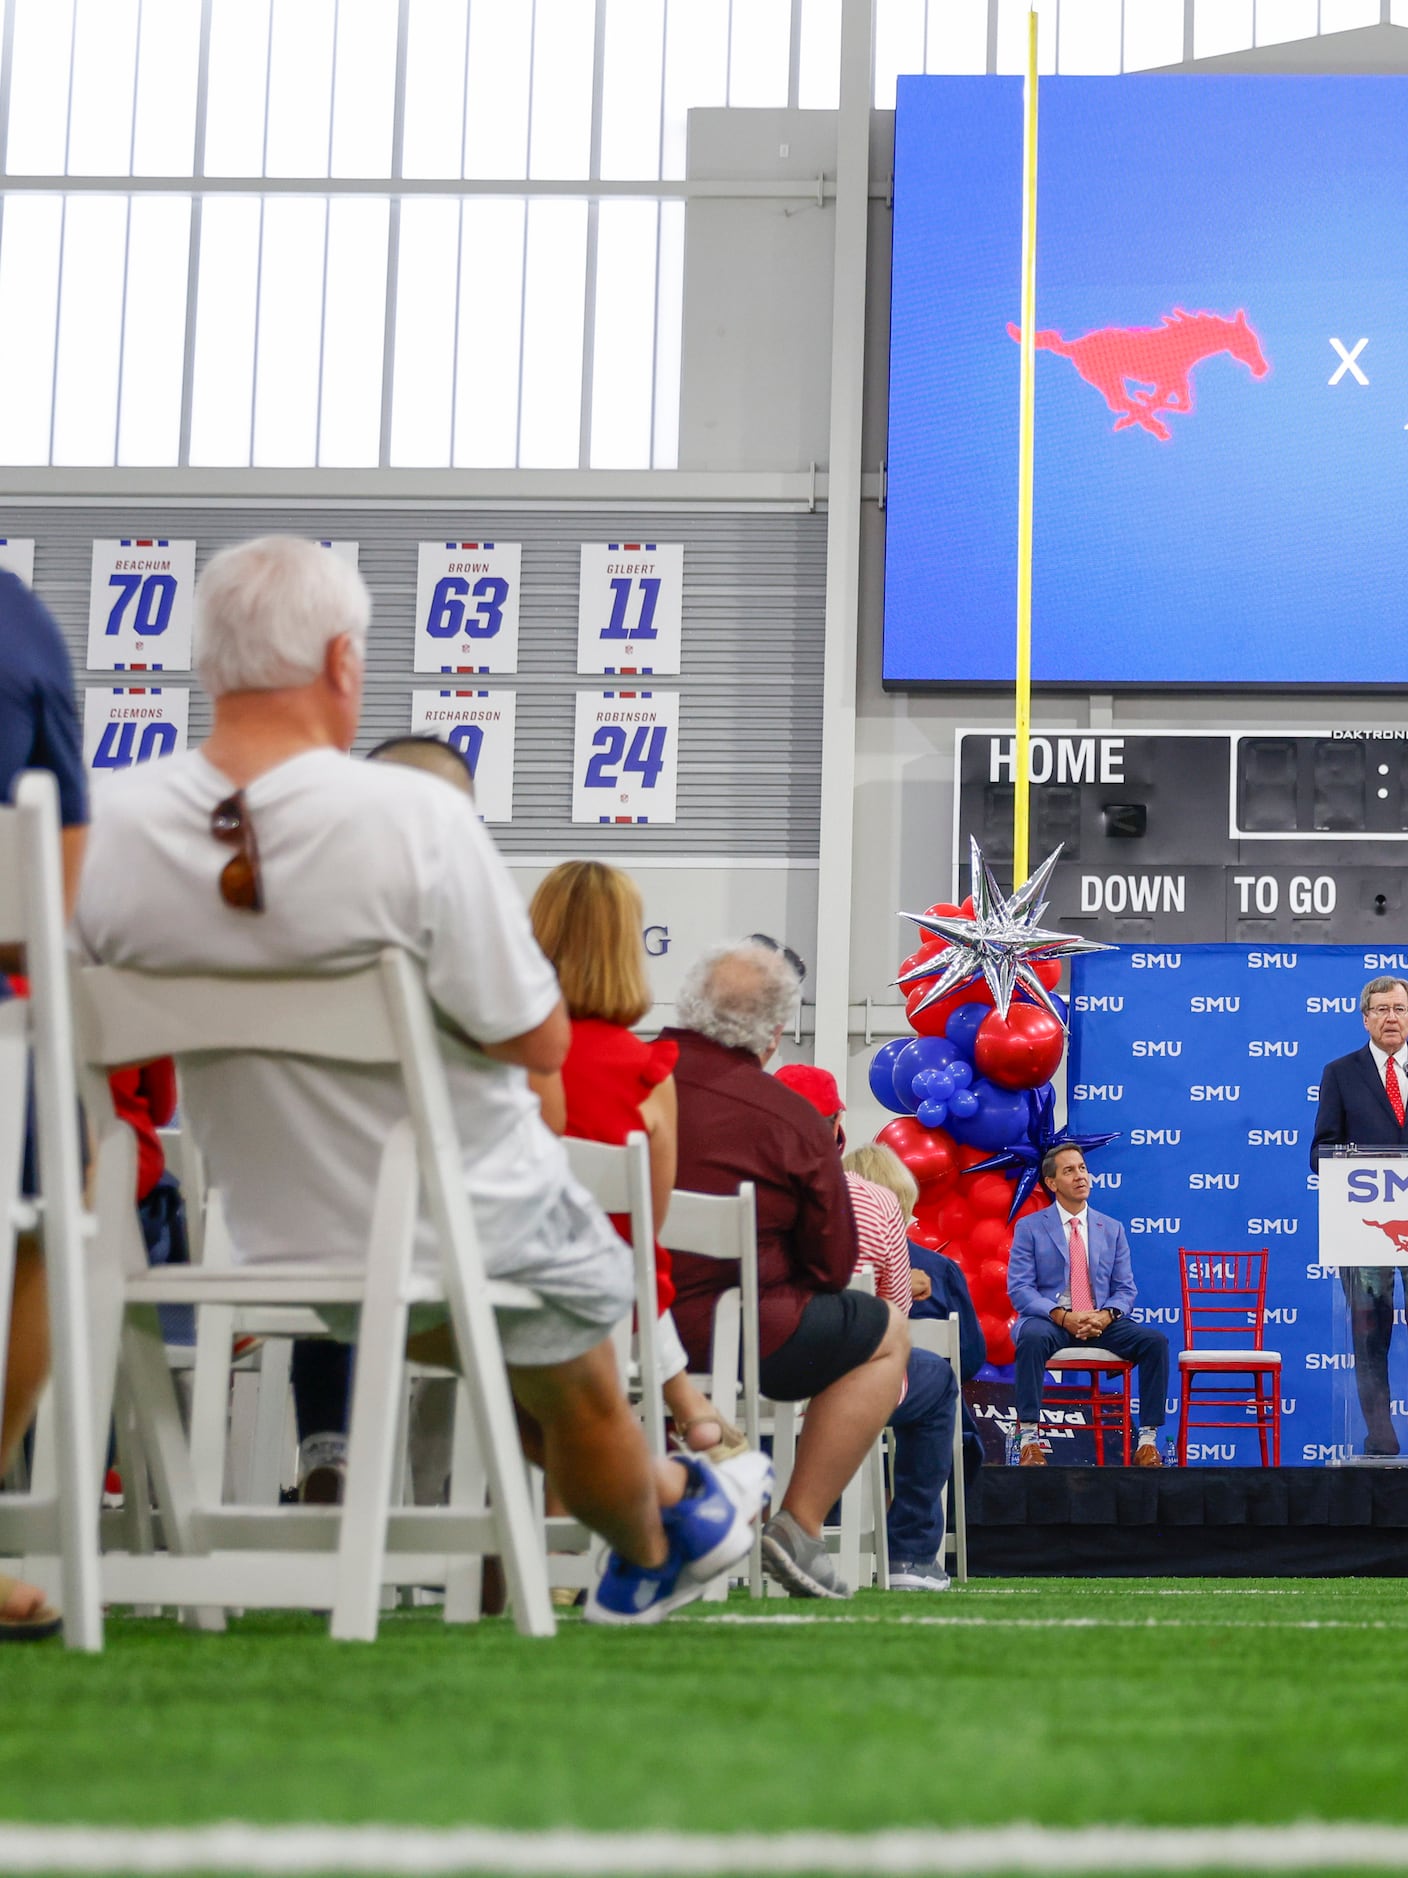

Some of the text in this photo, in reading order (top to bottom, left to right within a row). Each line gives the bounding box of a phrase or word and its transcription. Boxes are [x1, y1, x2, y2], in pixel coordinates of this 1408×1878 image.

[1327, 337, 1370, 385] X
[115, 560, 171, 570] BEACHUM
[448, 563, 490, 573] BROWN
[607, 564, 655, 574] GILBERT
[105, 574, 178, 635] 70
[426, 577, 510, 638] 63
[600, 578, 662, 639] 11
[110, 708, 163, 718] CLEMONS
[425, 711, 501, 721] RICHARDSON
[596, 712, 657, 722] ROBINSON
[584, 726, 668, 788] 24
[989, 737, 1125, 784] HOME
[1080, 875, 1185, 913] DOWN
[1233, 875, 1337, 914] TO GO
[1131, 953, 1181, 969] SMU
[1248, 953, 1297, 969] SMU
[1075, 996, 1124, 1012] SMU
[1190, 997, 1240, 1013] SMU
[1306, 998, 1356, 1013] SMU
[1132, 1041, 1182, 1057] SMU
[1249, 1041, 1298, 1057] SMU
[1073, 1085, 1123, 1100] SMU
[1190, 1086, 1240, 1101] SMU
[1130, 1129, 1181, 1145] SMU
[1248, 1130, 1298, 1145] SMU
[1089, 1173, 1122, 1189] MU
[1189, 1174, 1240, 1189] SMU
[1130, 1218, 1181, 1233] SMU
[1247, 1219, 1298, 1234] SMU
[1189, 1263, 1237, 1278] SMU
[1306, 1264, 1341, 1279] SM
[1131, 1308, 1180, 1324] SMU
[1247, 1308, 1298, 1324] SMU
[1305, 1353, 1355, 1369] SMU
[1130, 1398, 1179, 1414] SU
[1245, 1399, 1296, 1415] SU
[1186, 1444, 1236, 1460] SMU
[1303, 1444, 1354, 1460] SMU
